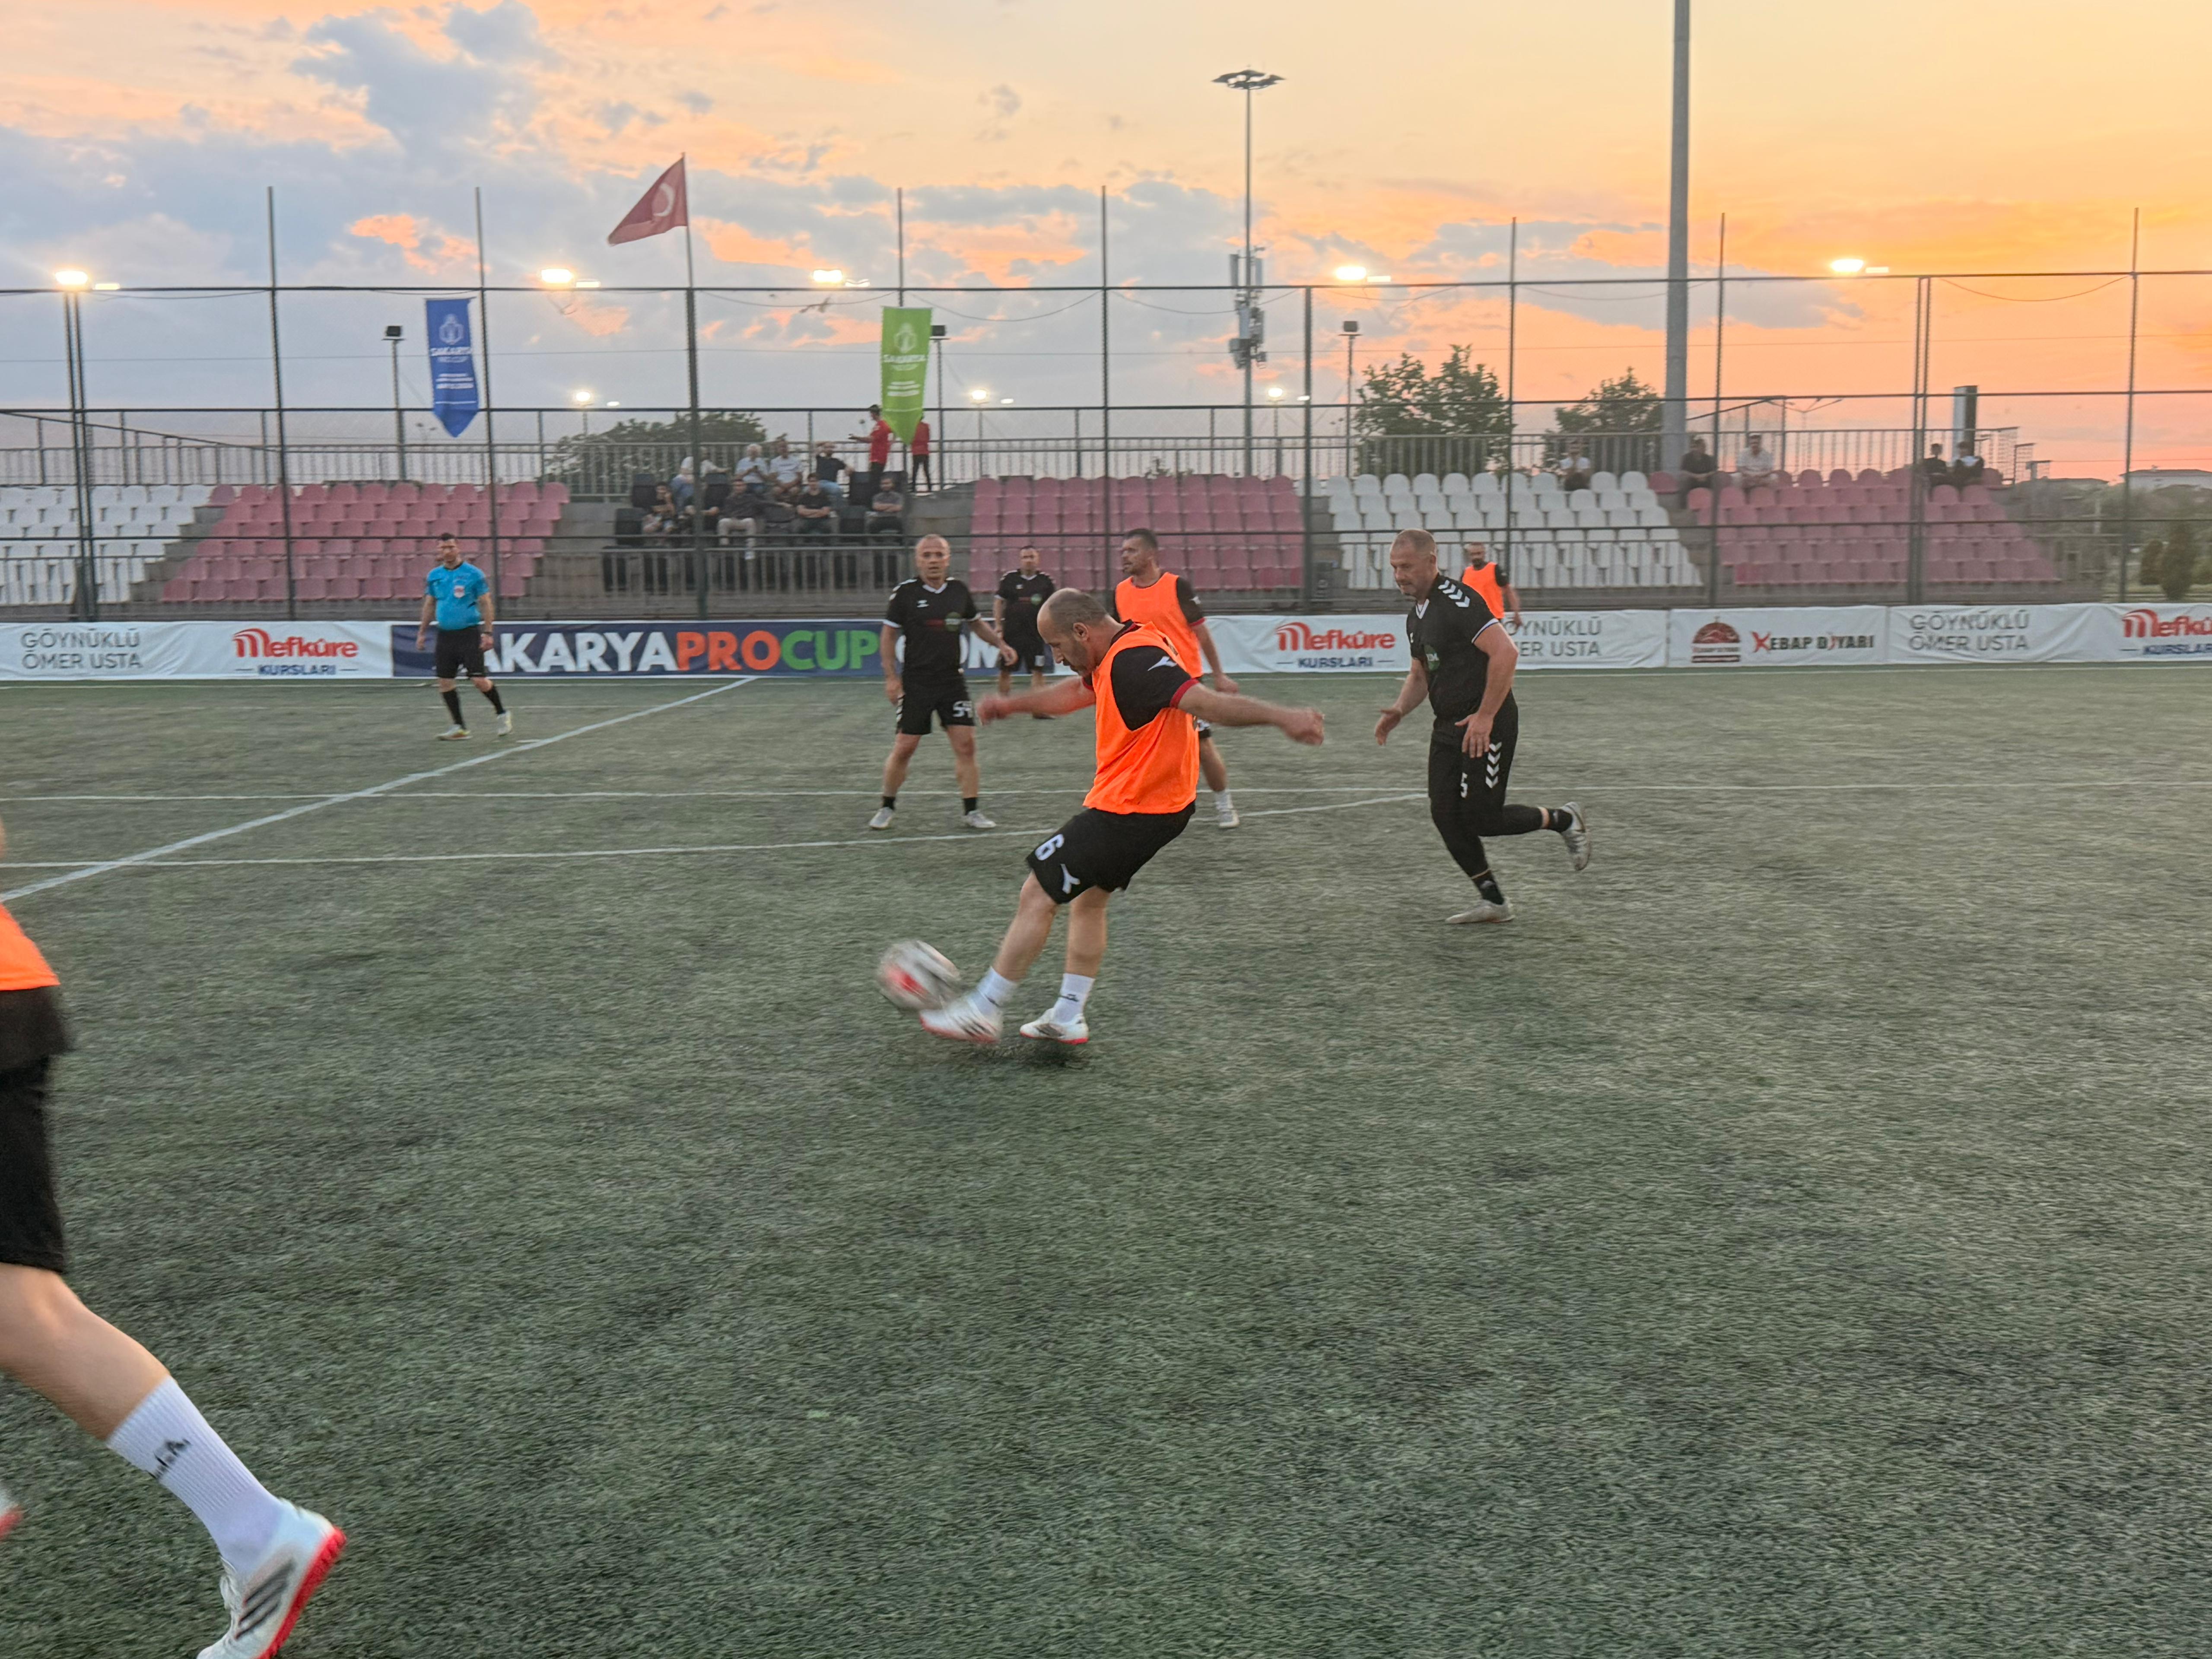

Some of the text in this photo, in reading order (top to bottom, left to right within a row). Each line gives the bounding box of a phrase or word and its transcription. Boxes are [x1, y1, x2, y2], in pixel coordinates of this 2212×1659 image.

[1502, 616, 1601, 636] ÖYNÜKLÜ
[22, 628, 140, 648] GÖYNÜKLÜ
[1976, 635, 2028, 650] USTA
[1551, 641, 1601, 657] USTA
[22, 650, 143, 669] ÖMER USTA
[1298, 657, 1373, 668] KURSLARI
[1035, 833, 1065, 861] 6
